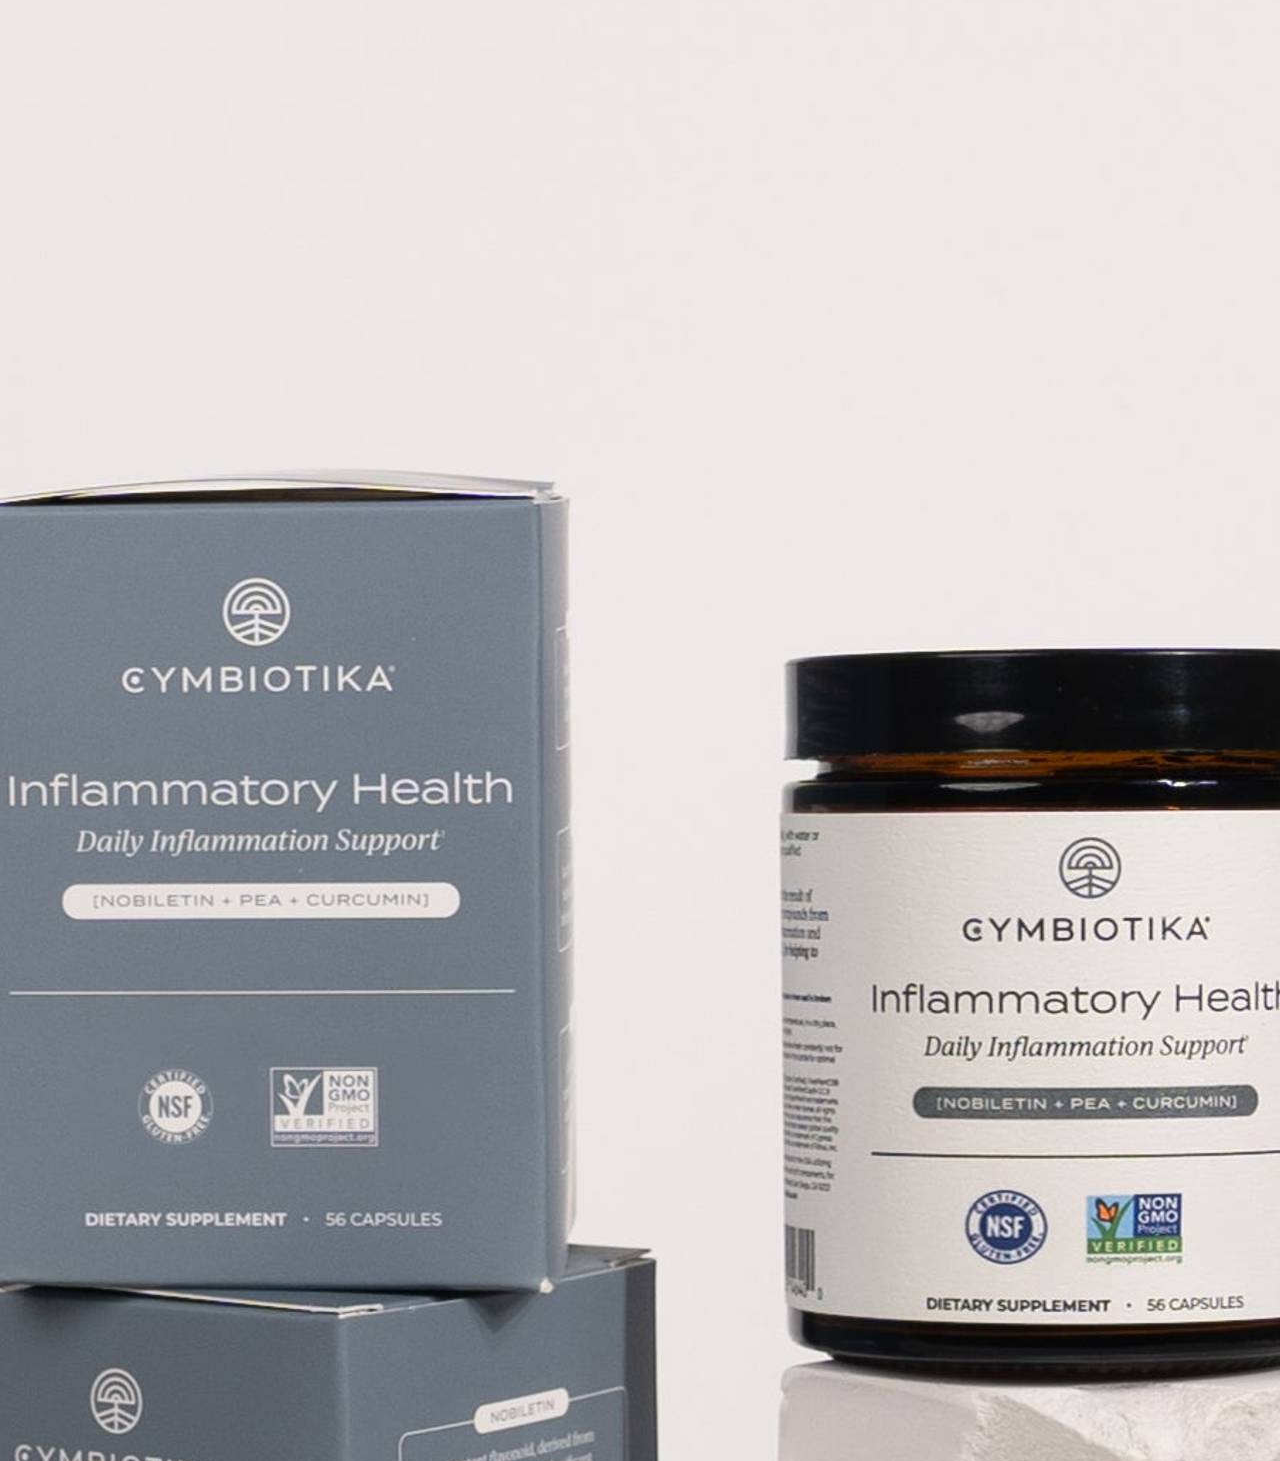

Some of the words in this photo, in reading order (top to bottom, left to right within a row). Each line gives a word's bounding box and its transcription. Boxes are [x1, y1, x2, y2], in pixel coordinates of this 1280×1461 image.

[7, 773, 338, 813] Inflammatory
[353, 771, 514, 805] Health
[76, 830, 144, 856] Daily
[150, 829, 329, 856] Inflammation
[92, 893, 215, 909] [NOBILETIN
[239, 893, 282, 908] PEA
[306, 892, 429, 908] CURCUMIN]
[872, 983, 1161, 1020] Inflammatory
[924, 1036, 982, 1060] Daily
[987, 1036, 1154, 1060] Inflammation
[144, 1069, 207, 1096] CERTIFIED
[329, 1075, 370, 1088] NON
[328, 1089, 370, 1101] GMO
[936, 1096, 1047, 1111] [NOBILETIN
[1071, 1096, 1110, 1111] PEA
[1132, 1094, 1238, 1110] CURCUMIN]
[157, 1095, 193, 1118] NSF
[328, 1102, 370, 1115] Project
[280, 1118, 370, 1129] VERIFIED
[975, 1192, 1038, 1216] CERTIFIED
[1138, 1197, 1178, 1210] NON
[85, 1213, 163, 1227] DIETARY
[166, 1213, 286, 1227] SUPPLEMENT
[325, 1213, 346, 1227] 56
[350, 1213, 442, 1227] CAPSULES
[1138, 1210, 1178, 1223] GMO
[986, 1215, 1024, 1239] NSF
[1137, 1224, 1178, 1237] Project
[970, 1231, 1043, 1262] GLUTEN-FREE
[1092, 1239, 1179, 1252] VERIFIED
[1086, 1254, 1182, 1265] nongmoproject.org
[926, 1297, 993, 1312] DIETARY
[997, 1299, 1110, 1313] SUPPLEMENT
[1147, 1298, 1165, 1312] 56
[1169, 1296, 1245, 1311] CAPSULES
[490, 1400, 555, 1424] NOBILETIN
